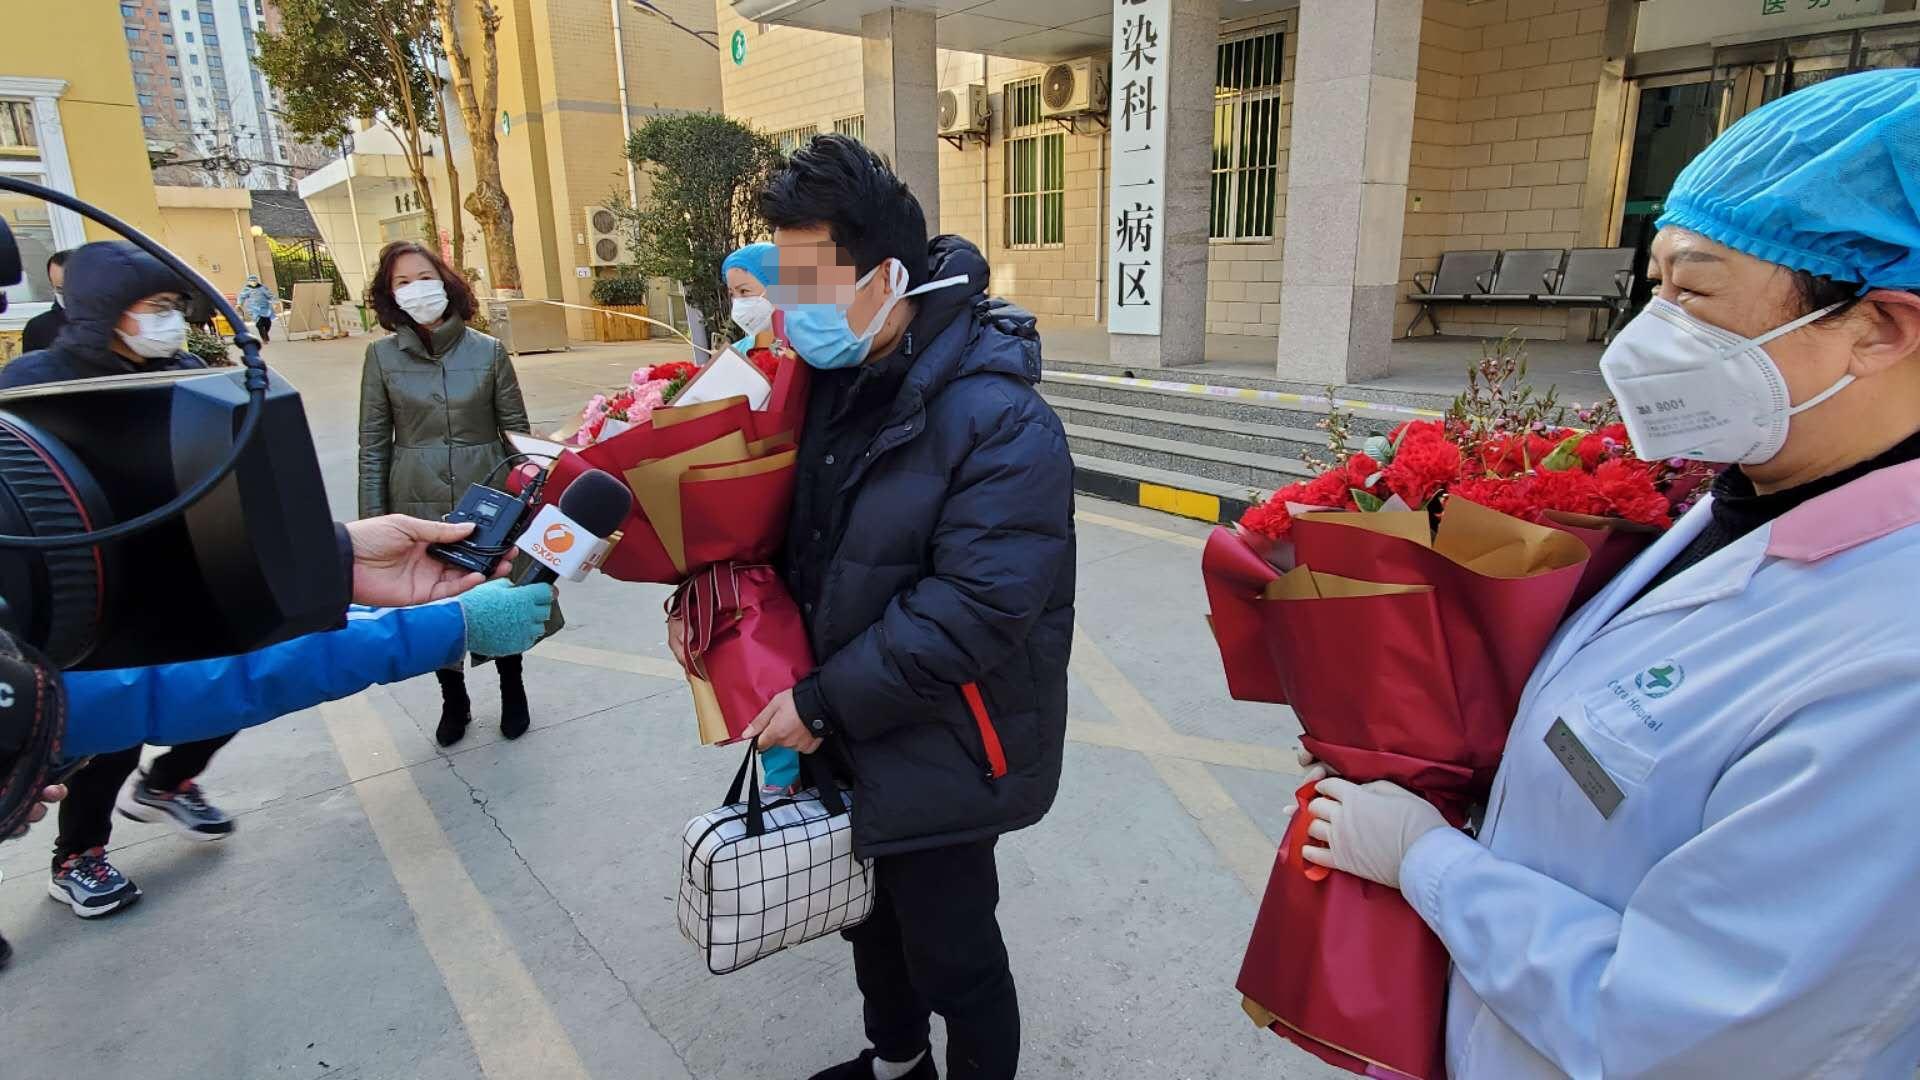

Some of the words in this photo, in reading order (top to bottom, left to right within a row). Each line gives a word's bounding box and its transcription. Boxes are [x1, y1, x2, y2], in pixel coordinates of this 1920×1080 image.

[1116, 0, 1158, 307] 染科二病区
[1655, 398, 1686, 413] 9001
